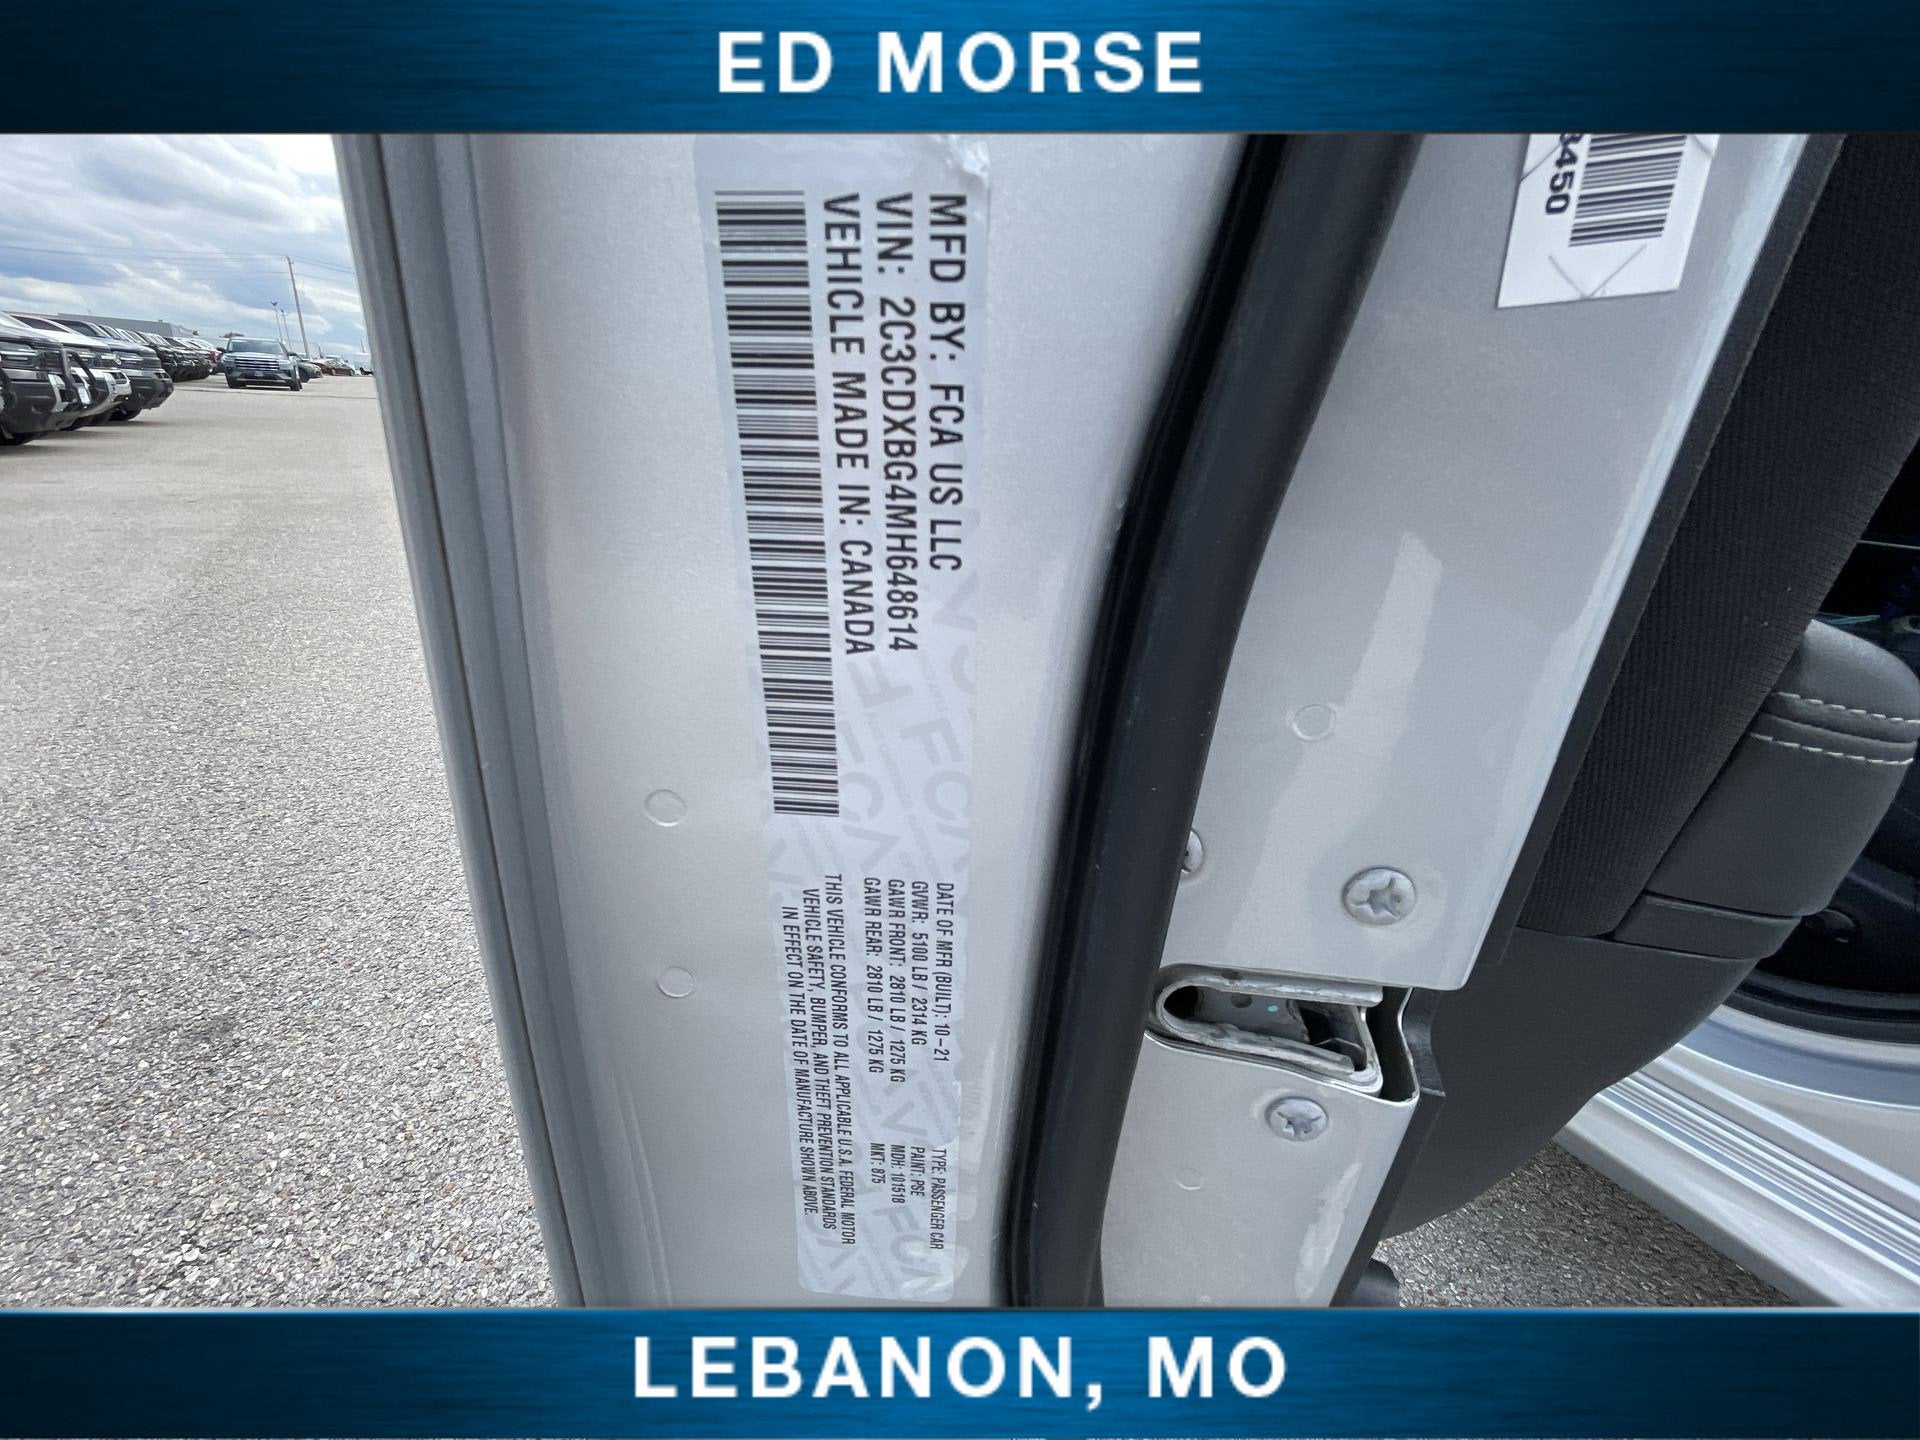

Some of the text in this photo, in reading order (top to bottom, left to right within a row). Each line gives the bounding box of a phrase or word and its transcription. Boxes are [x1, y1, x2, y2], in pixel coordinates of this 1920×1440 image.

[929, 195, 966, 570] MFD BY: FCA US LLC
[824, 193, 874, 654] VEHICLE MADE IN: CANADA
[877, 194, 918, 650] VIN: 2C3CDXBG4MH648614
[863, 877, 882, 917] GAWR
[887, 879, 906, 919] GAWR
[911, 880, 929, 924] GVWR:
[936, 882, 955, 916] DATE
[865, 920, 883, 957] REAR:
[888, 922, 906, 967] FRONT:
[936, 919, 954, 937] OF
[911, 932, 929, 962] 5100
[935, 940, 954, 968] MFR
[866, 964, 884, 994] 2810
[889, 975, 906, 1004] 2810
[911, 966, 929, 982] LB
[867, 997, 884, 1013] LB
[911, 997, 928, 1025] 2314
[931, 971, 953, 1018] (BUILT):
[889, 1007, 906, 1023] LB
[867, 1029, 884, 1056] 1275
[889, 1039, 906, 1065] 1275
[911, 1029, 928, 1046] KG
[781, 906, 819, 1216] IN EFFECT ON THE DATE OF MANUFACTURE SHOWN ABOVE.
[802, 888, 838, 1230] VEHICLE SAFETY, BUMPER, AND THEFT PREVENTION STANDARDS
[824, 873, 856, 1245] THIS VEHICLE CONFORMS TO ALL APPLICABLE U.S.A. FEDERAL MOTOR
[868, 1058, 885, 1074] KG
[889, 1068, 906, 1083] KG
[870, 1142, 886, 1184] MKT: 875
[890, 1144, 906, 1204] MDH: 101518
[910, 1146, 926, 1197] PAINT: PSE
[929, 1148, 947, 1250] TYPE: PASSENGER CAR
